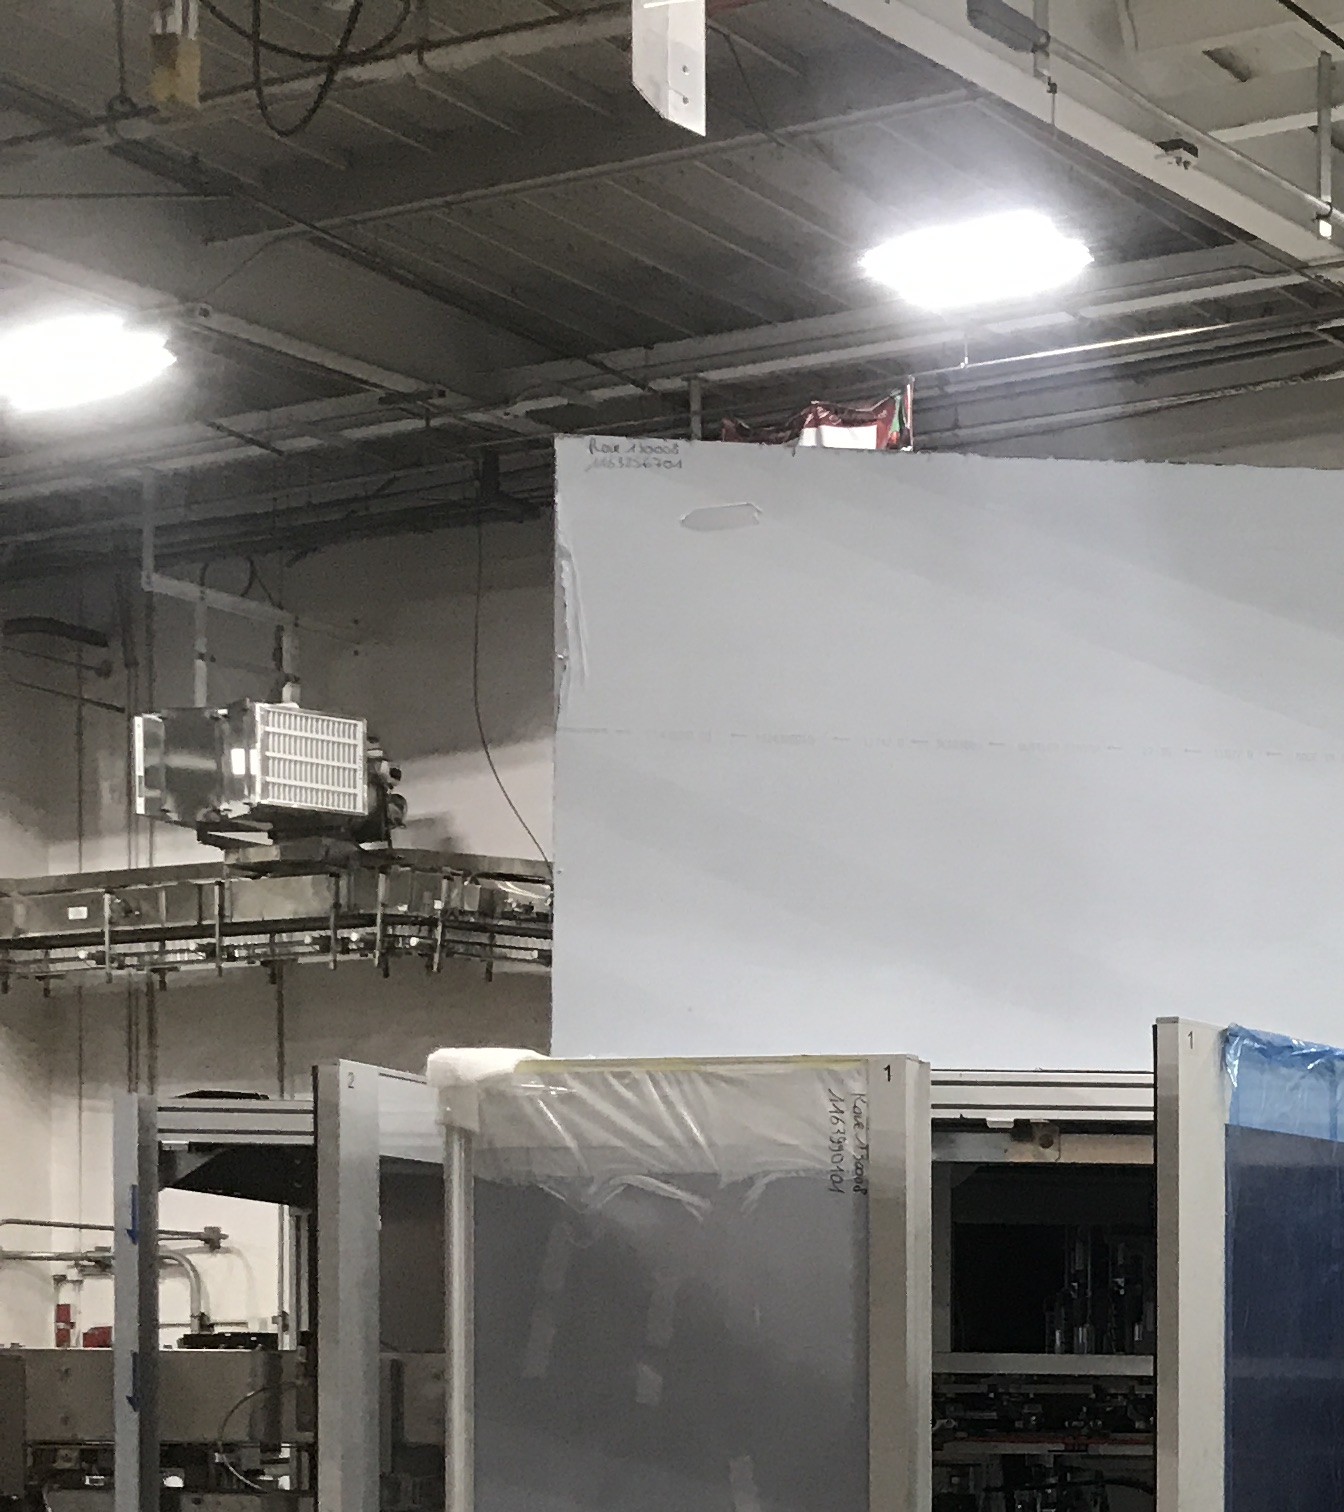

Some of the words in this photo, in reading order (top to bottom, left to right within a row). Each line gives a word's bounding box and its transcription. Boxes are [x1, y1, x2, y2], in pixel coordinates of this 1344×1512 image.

[1187, 1031, 1193, 1049] 1
[348, 1072, 355, 1089] 2
[884, 1064, 891, 1082] 1
